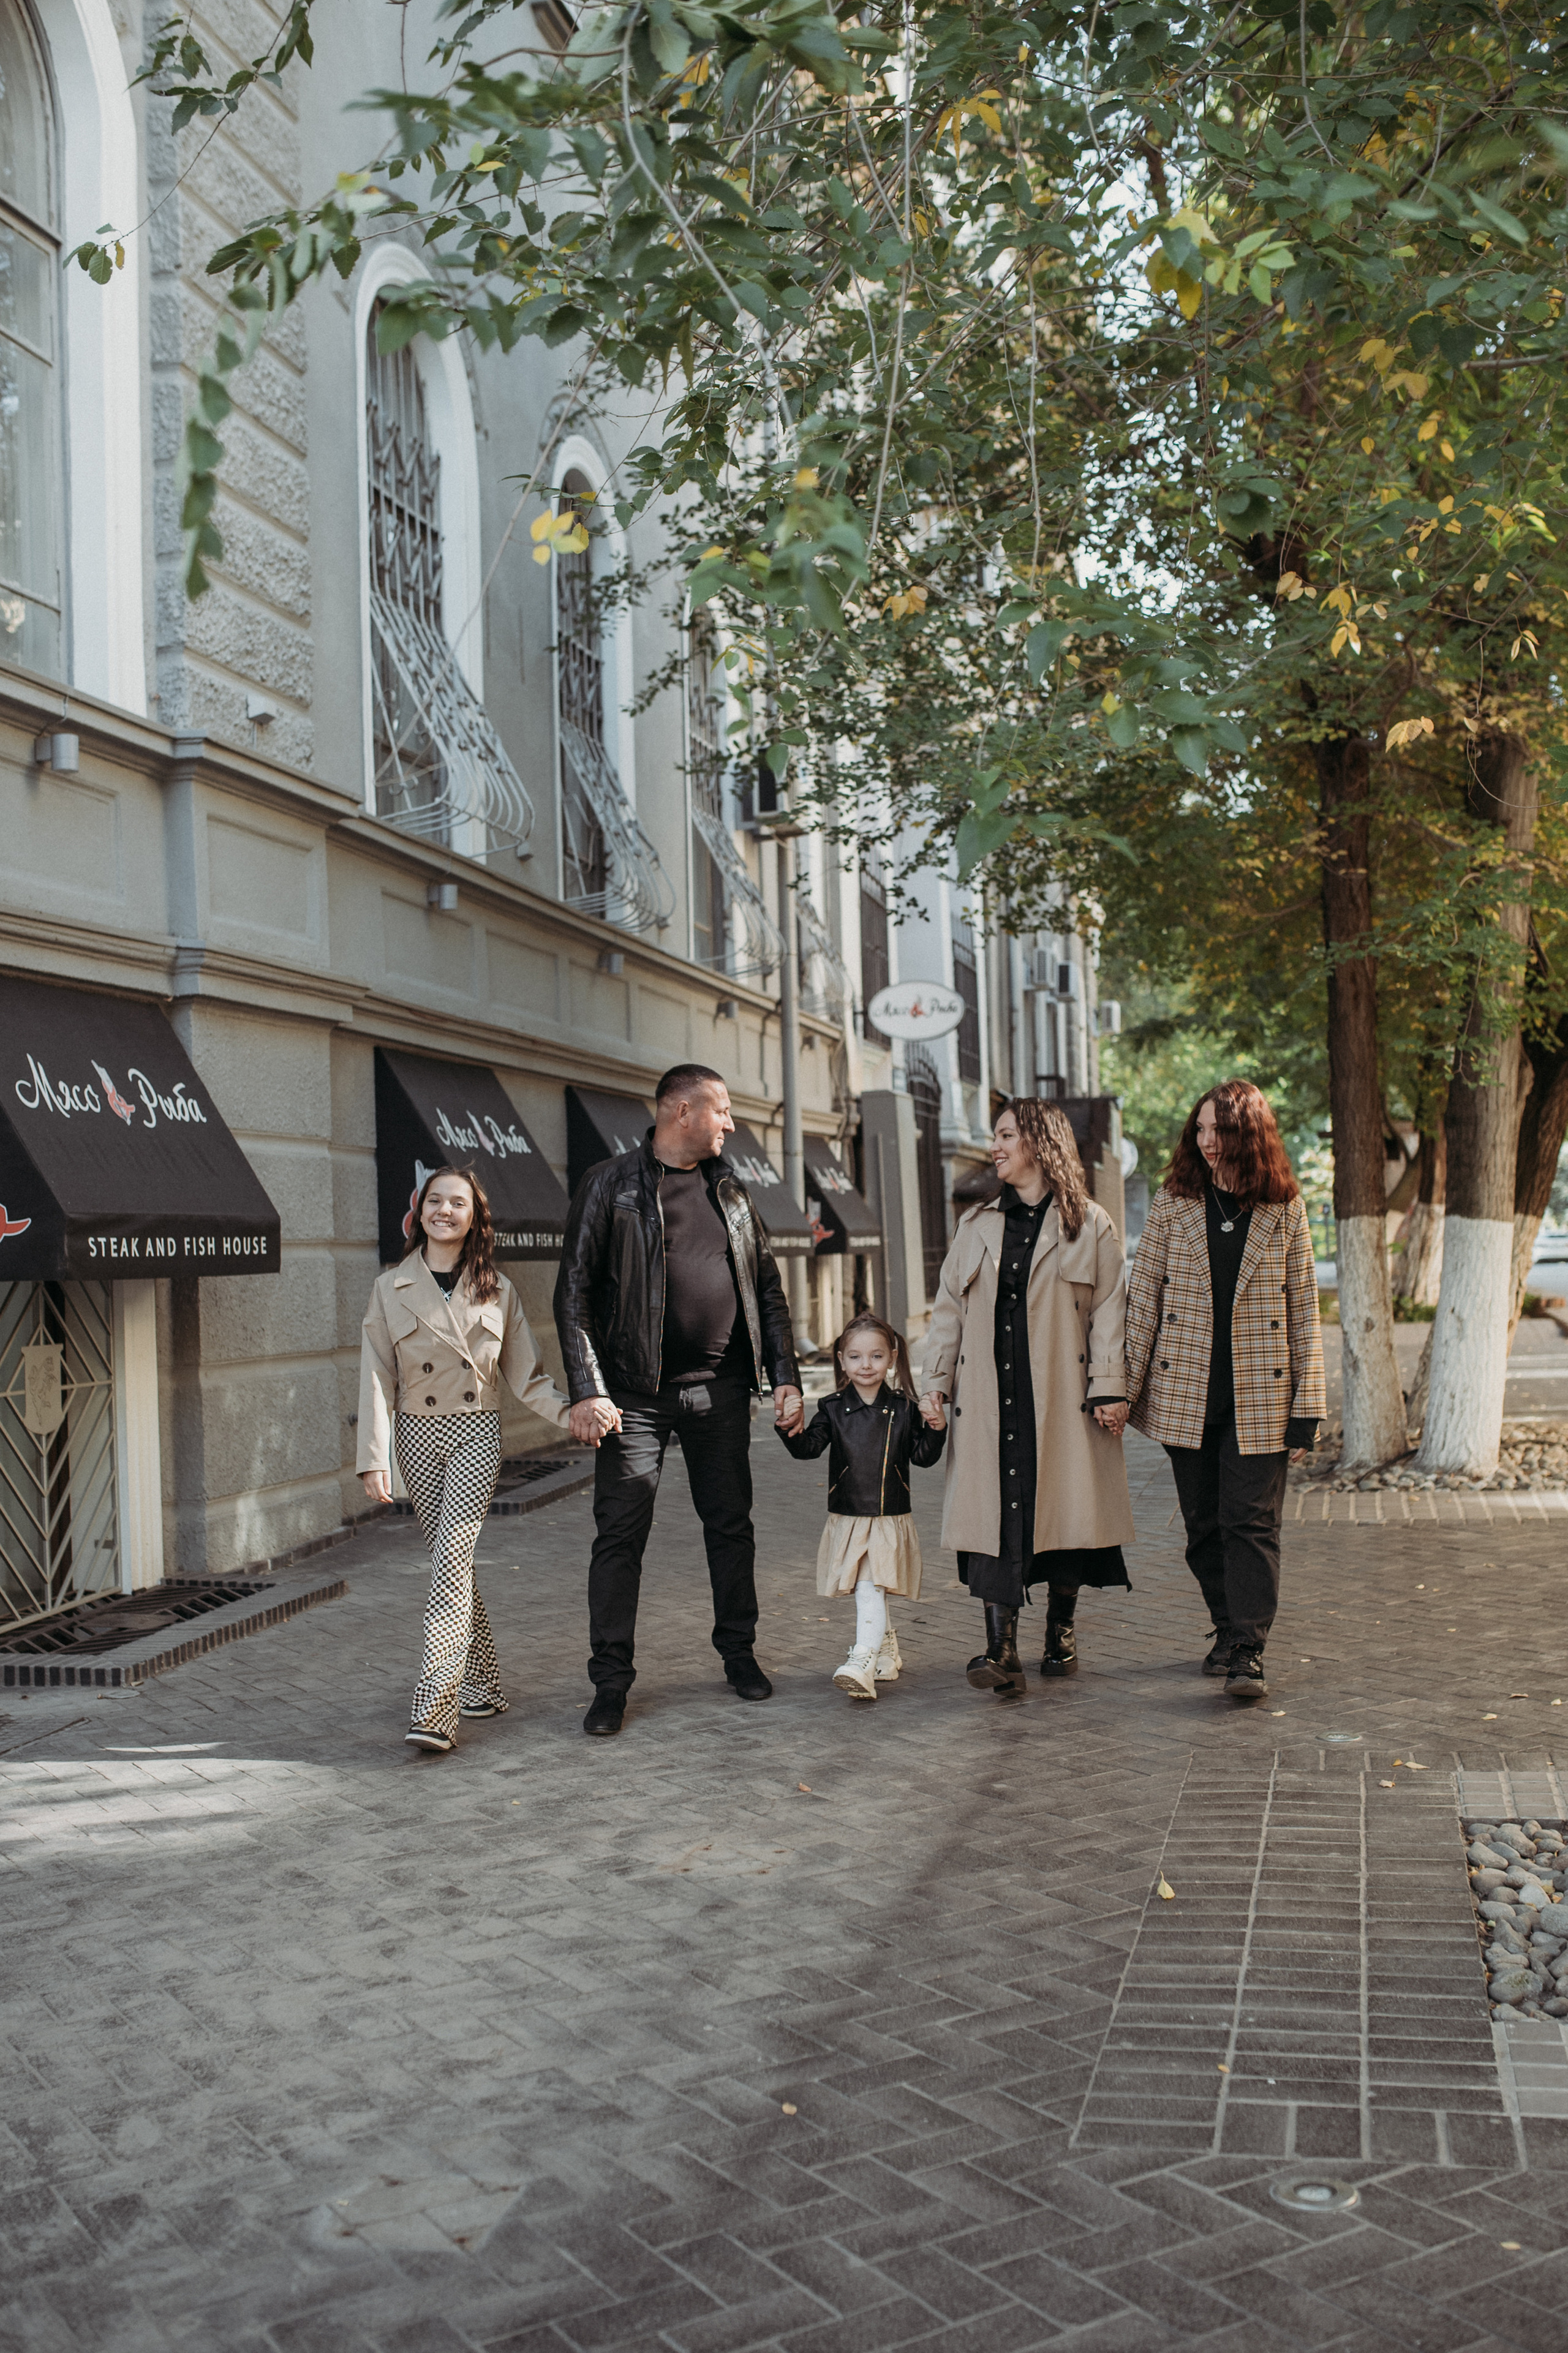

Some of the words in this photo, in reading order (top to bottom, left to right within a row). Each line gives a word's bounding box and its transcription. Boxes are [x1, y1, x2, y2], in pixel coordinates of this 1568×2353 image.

[15, 1053, 101, 1118] Мясо
[128, 1068, 207, 1128] Рыба
[88, 1237, 140, 1257] STEAK
[145, 1237, 176, 1257] AND
[184, 1236, 216, 1256] FISH
[222, 1236, 267, 1255] HOUSE
[518, 1232, 534, 1247] AND
[536, 1232, 553, 1247] FISH
